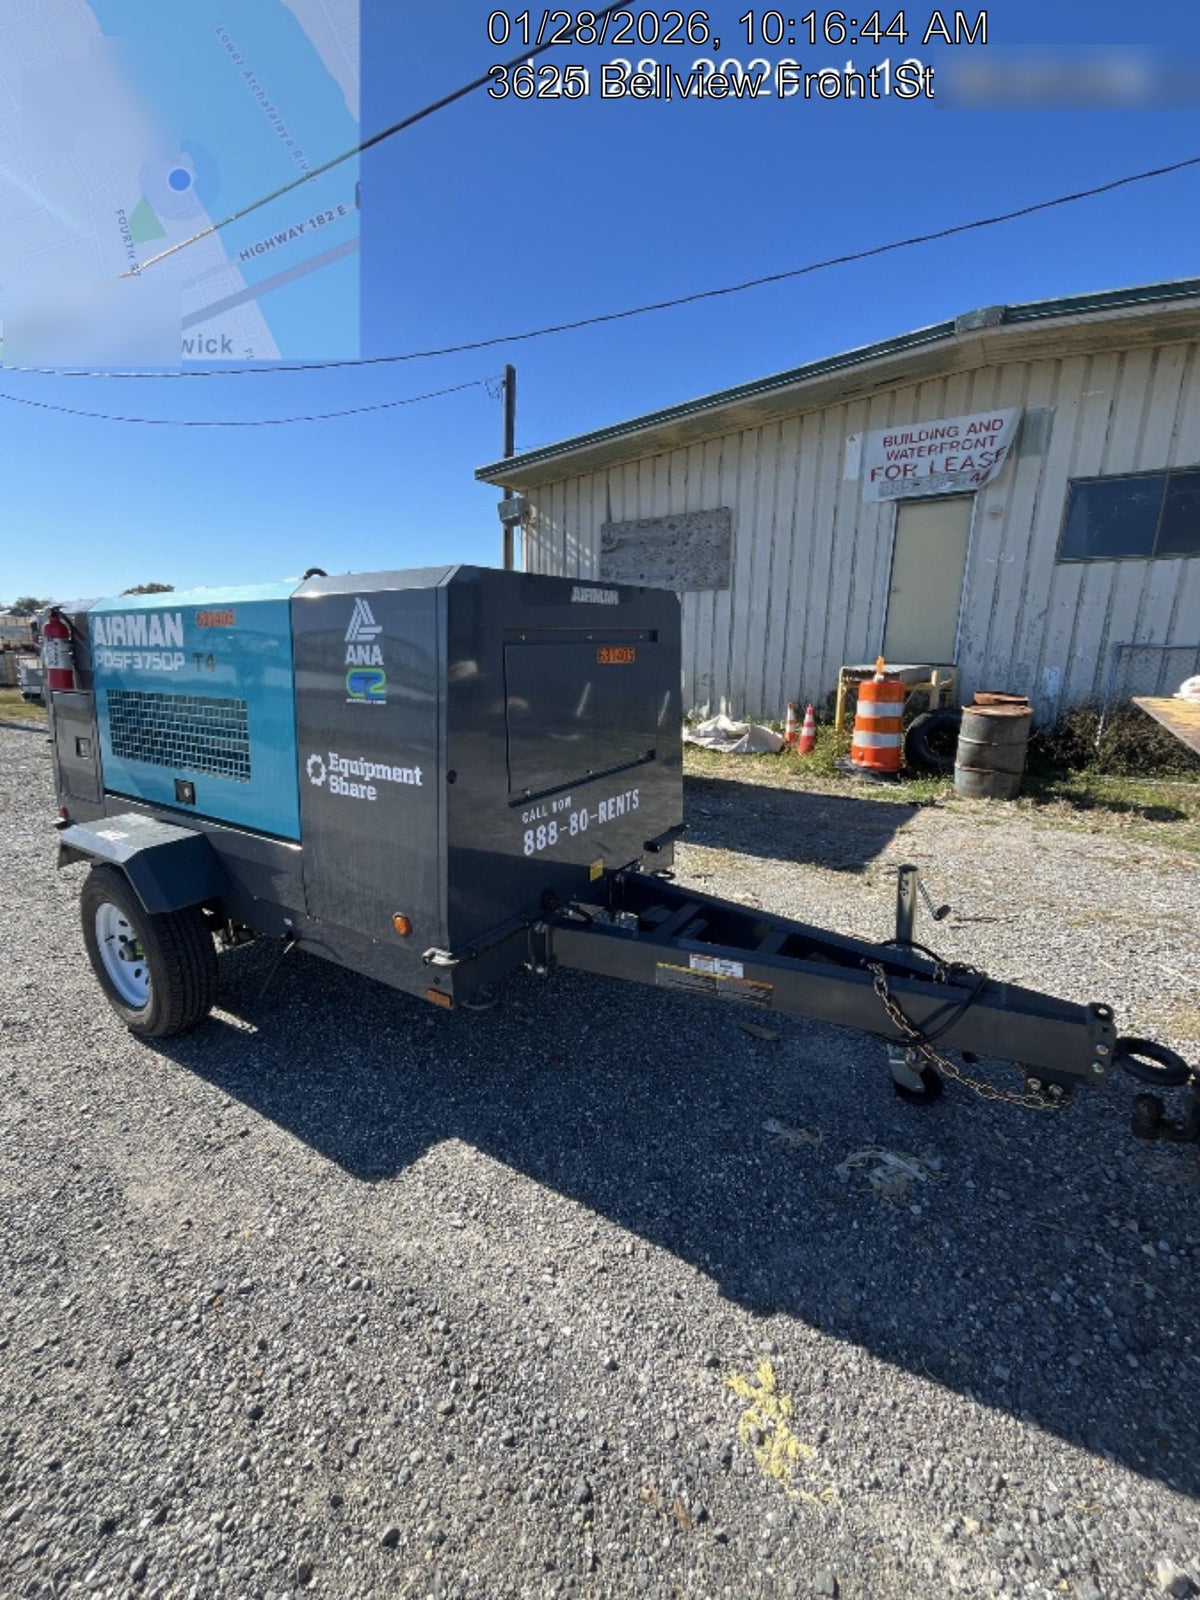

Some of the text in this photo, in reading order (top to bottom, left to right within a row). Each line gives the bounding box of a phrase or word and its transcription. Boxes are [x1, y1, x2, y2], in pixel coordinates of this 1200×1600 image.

[883, 419, 1004, 449] BUILDING AND
[886, 435, 998, 462] WATERFRONT
[870, 463, 918, 483] FOR
[571, 586, 619, 605] AIRMAN
[94, 613, 184, 648] AIRMAN
[344, 645, 384, 666] ANA
[328, 752, 423, 786] Equipment
[329, 774, 378, 801] Share
[522, 796, 572, 824] CALL NOW
[523, 788, 640, 856] 888-80-RENTS
